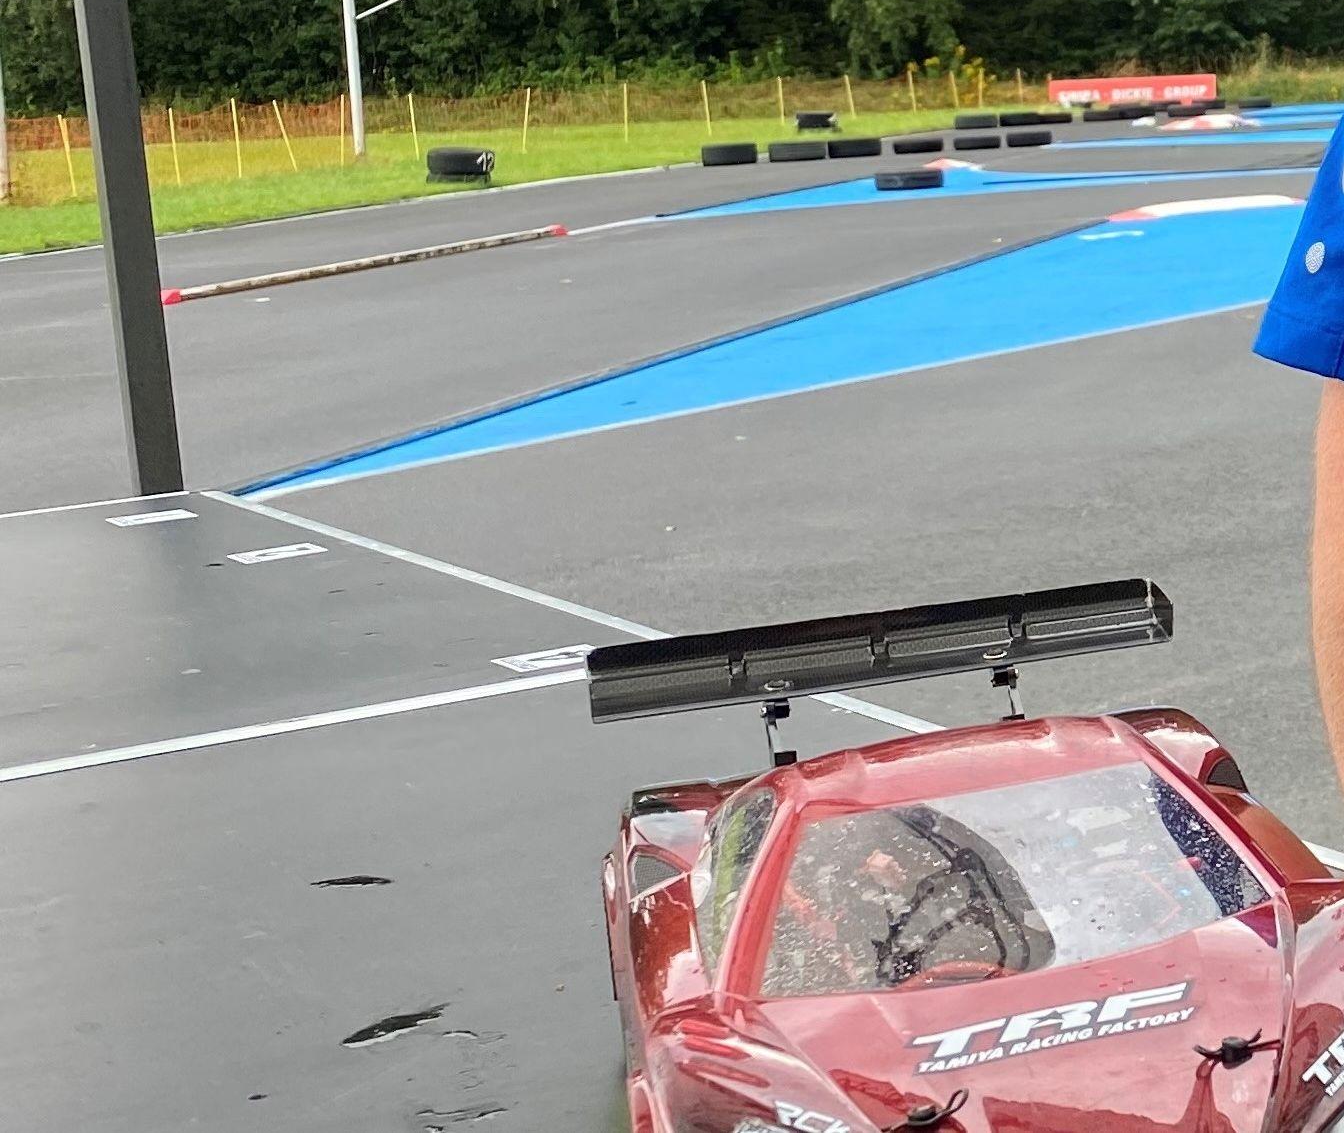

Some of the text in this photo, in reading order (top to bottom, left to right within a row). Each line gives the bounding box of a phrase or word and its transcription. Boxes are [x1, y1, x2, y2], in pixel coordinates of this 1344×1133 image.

[1163, 85, 1207, 97] GROUP
[912, 982, 1187, 1058] TRF
[918, 1007, 1194, 1074] TAMIYA RACING FACTORY
